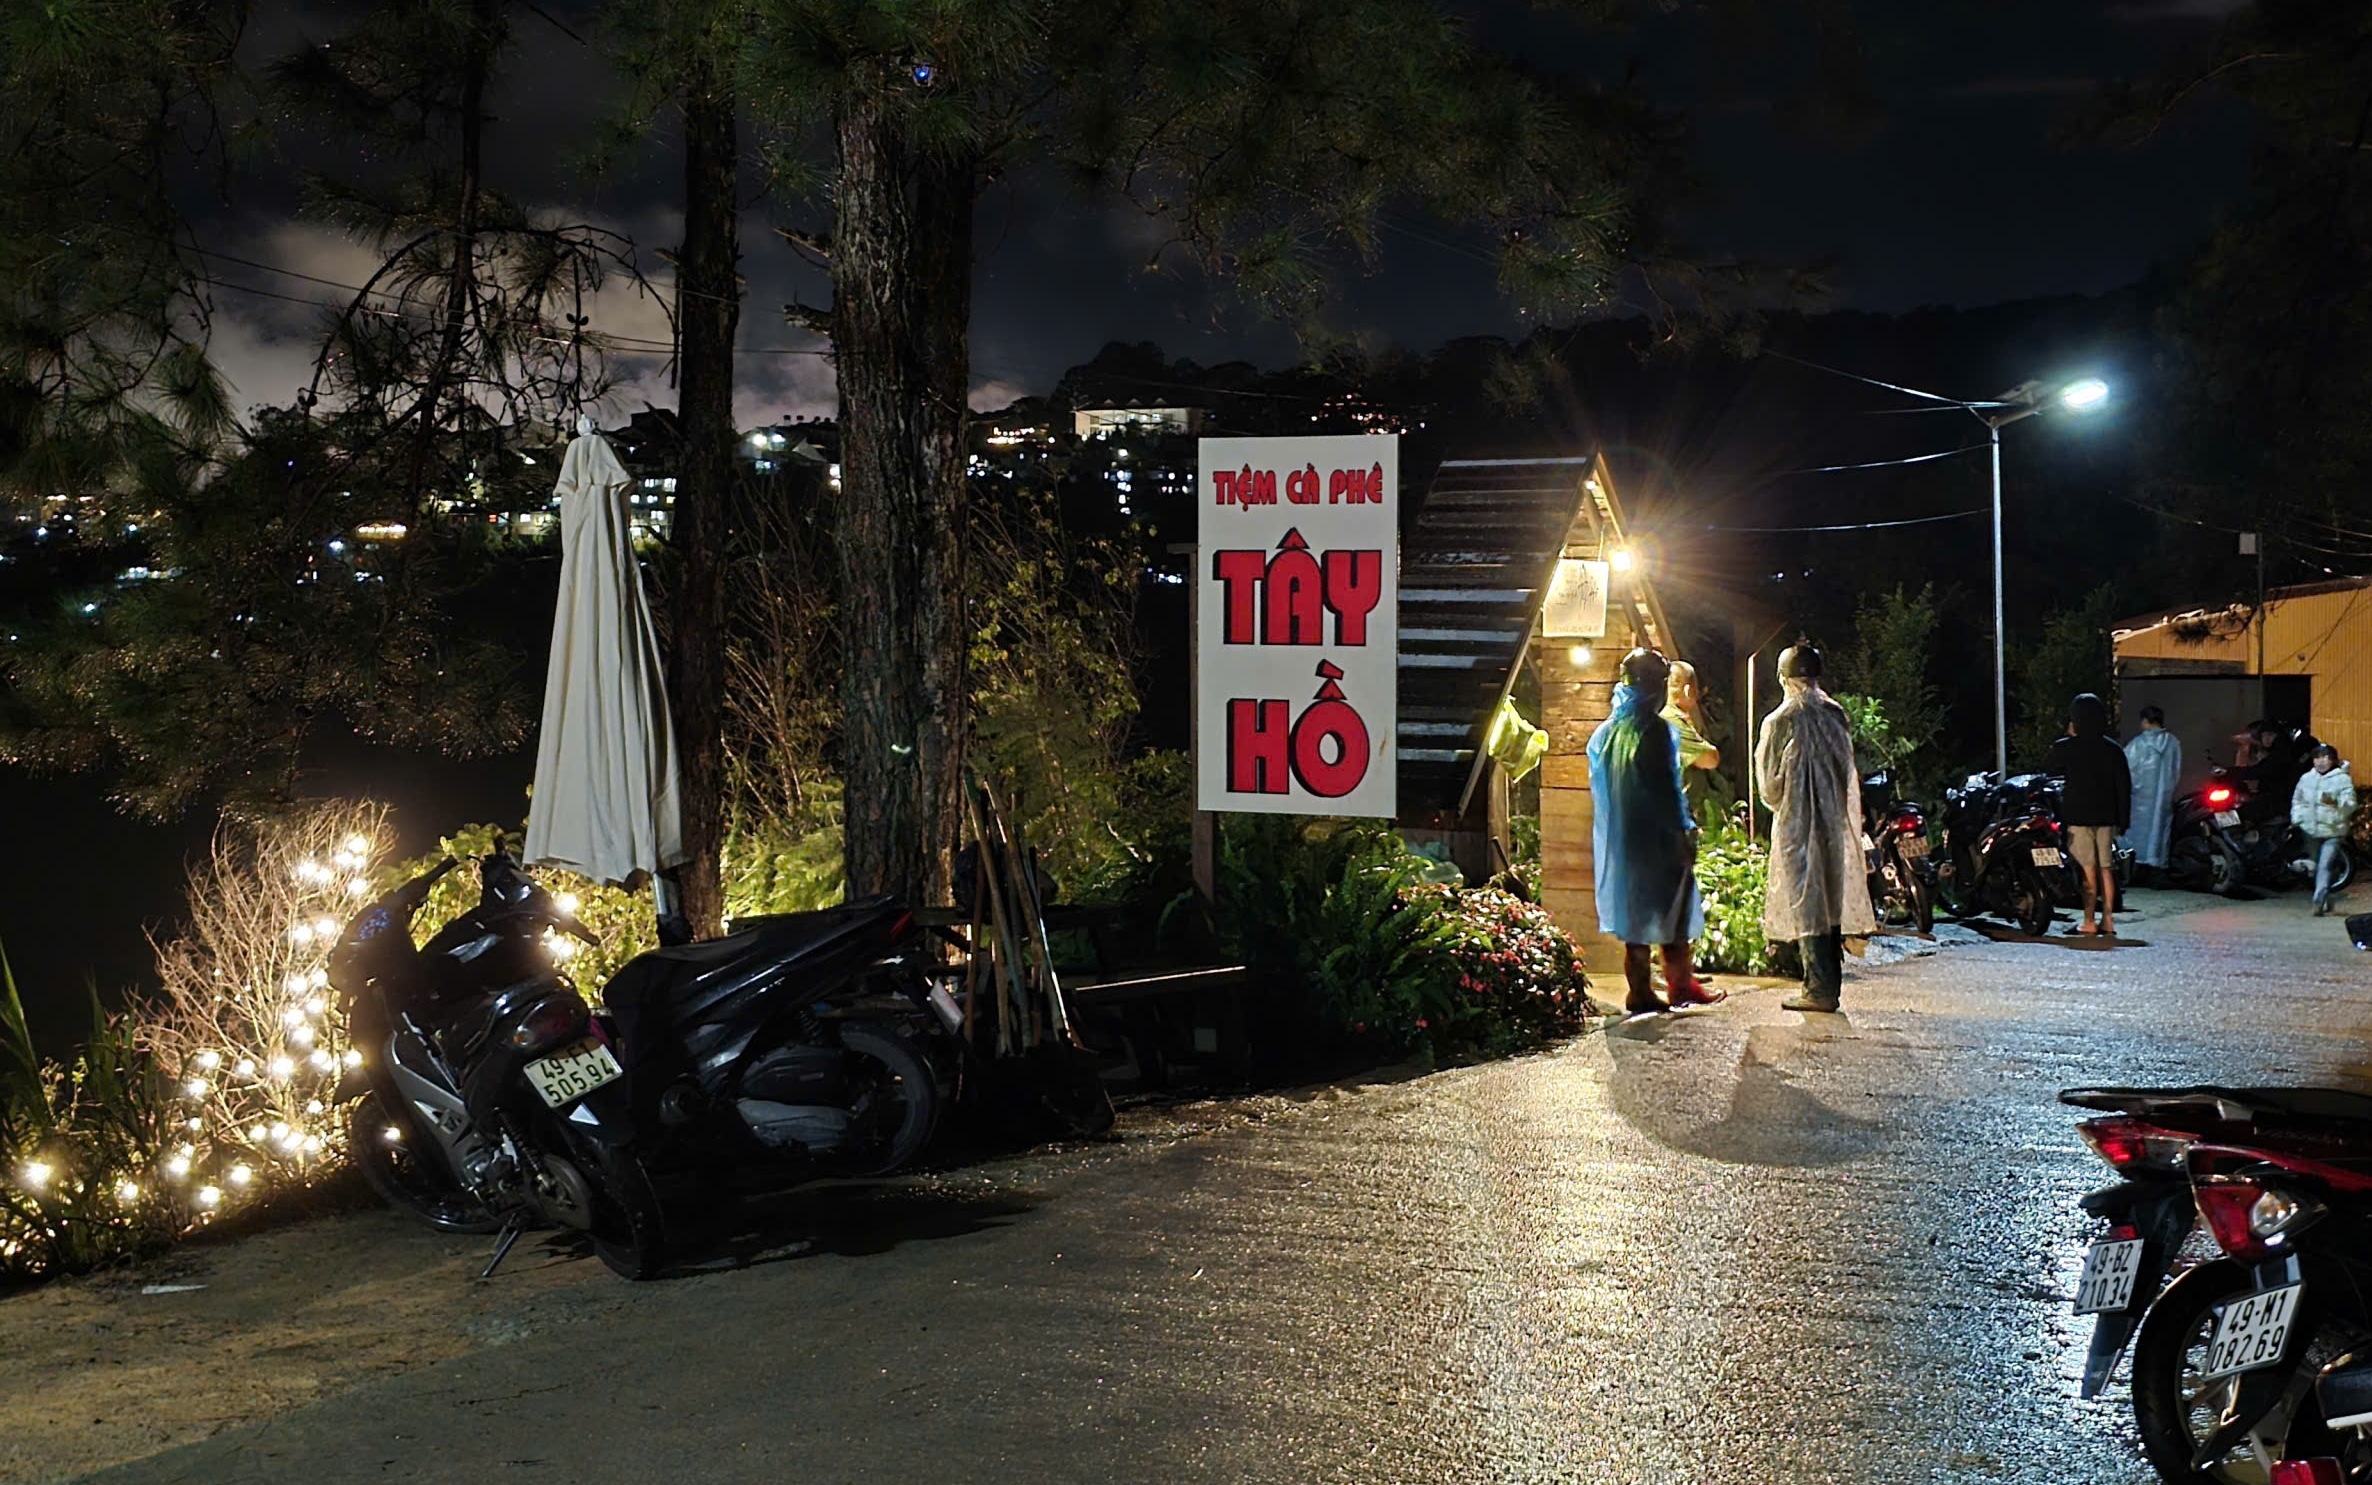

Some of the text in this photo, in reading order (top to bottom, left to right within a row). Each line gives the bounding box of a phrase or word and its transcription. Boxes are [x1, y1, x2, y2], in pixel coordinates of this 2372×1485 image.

[1213, 461, 1383, 512] TIỆM CÀ PHÊ
[1212, 527, 1382, 646] TÂY
[1226, 658, 1370, 798] HỒ
[543, 1058, 615, 1103] 505.94
[2076, 1275, 2130, 1310] 210.34
[2209, 1325, 2285, 1373] 082.69
